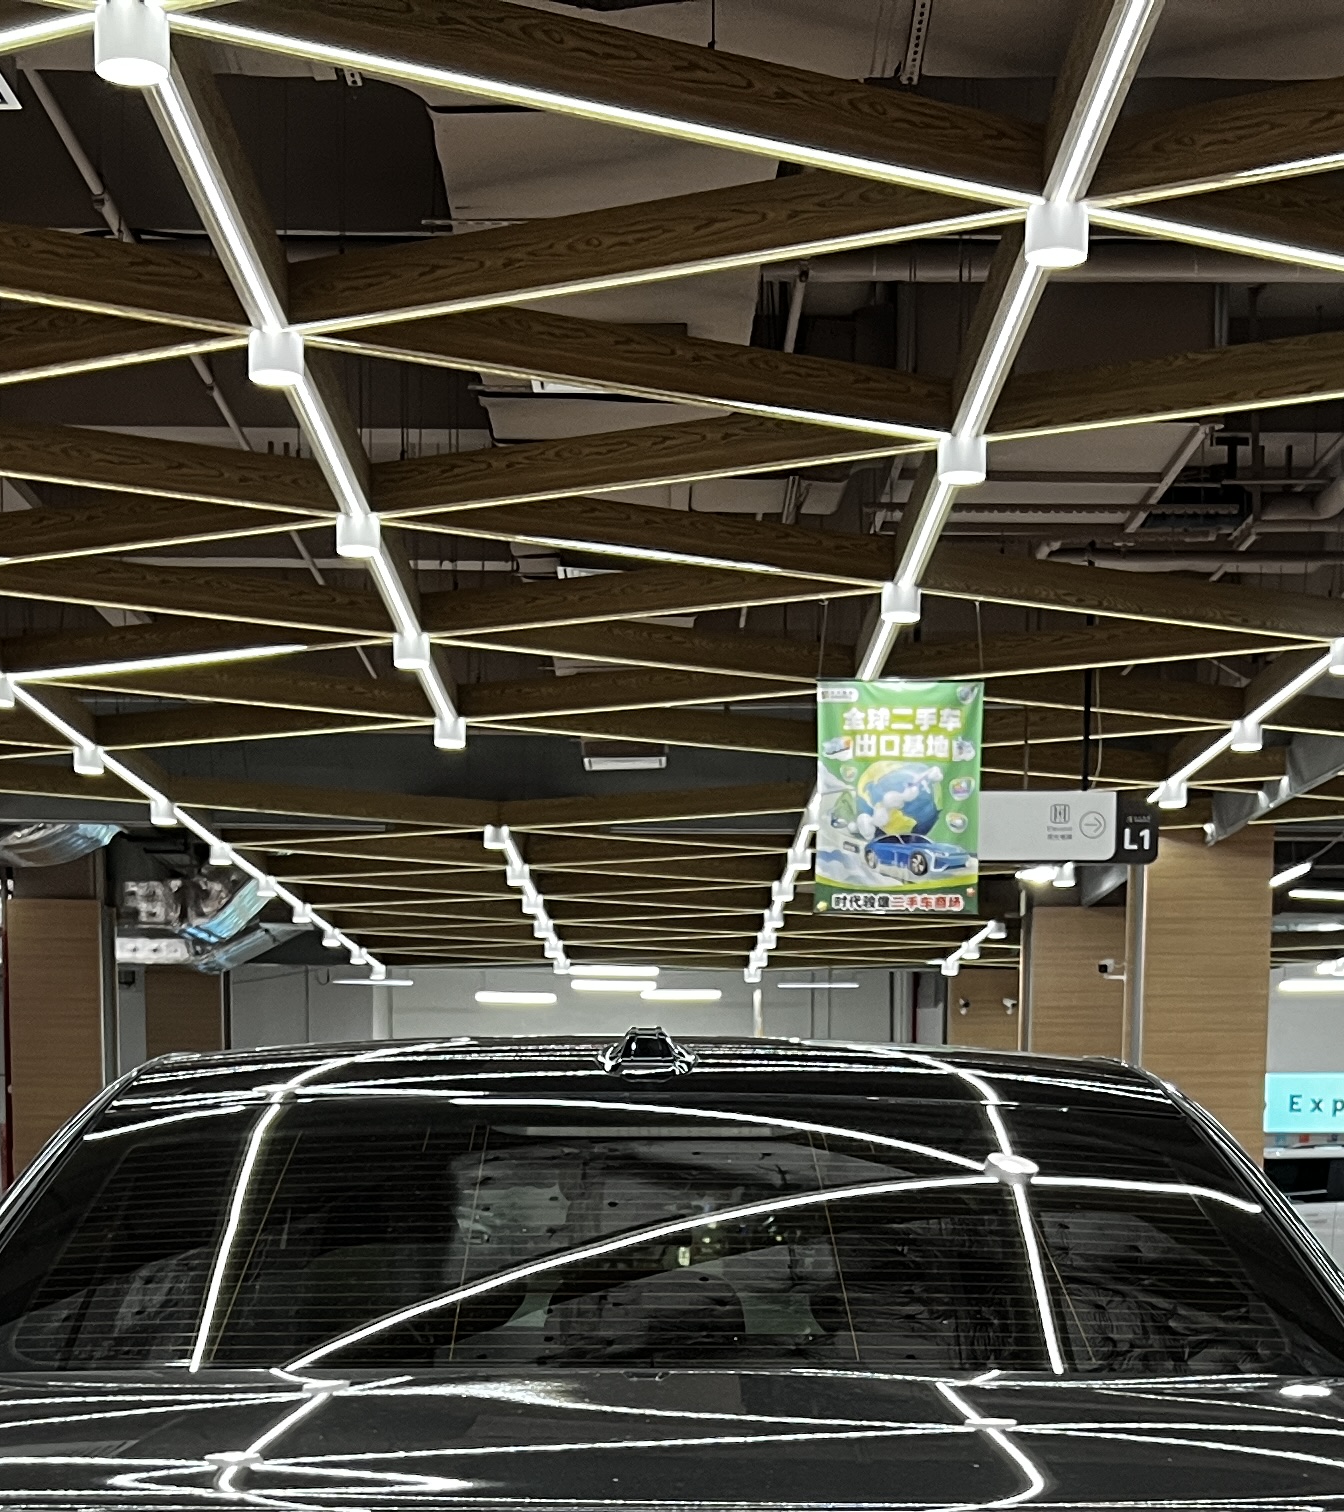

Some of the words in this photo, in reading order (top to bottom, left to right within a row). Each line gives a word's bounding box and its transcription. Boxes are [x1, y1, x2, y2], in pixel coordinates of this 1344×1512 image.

[843, 707, 962, 732] 全球二手车
[855, 734, 949, 757] 出口基地
[1123, 828, 1150, 850] L1
